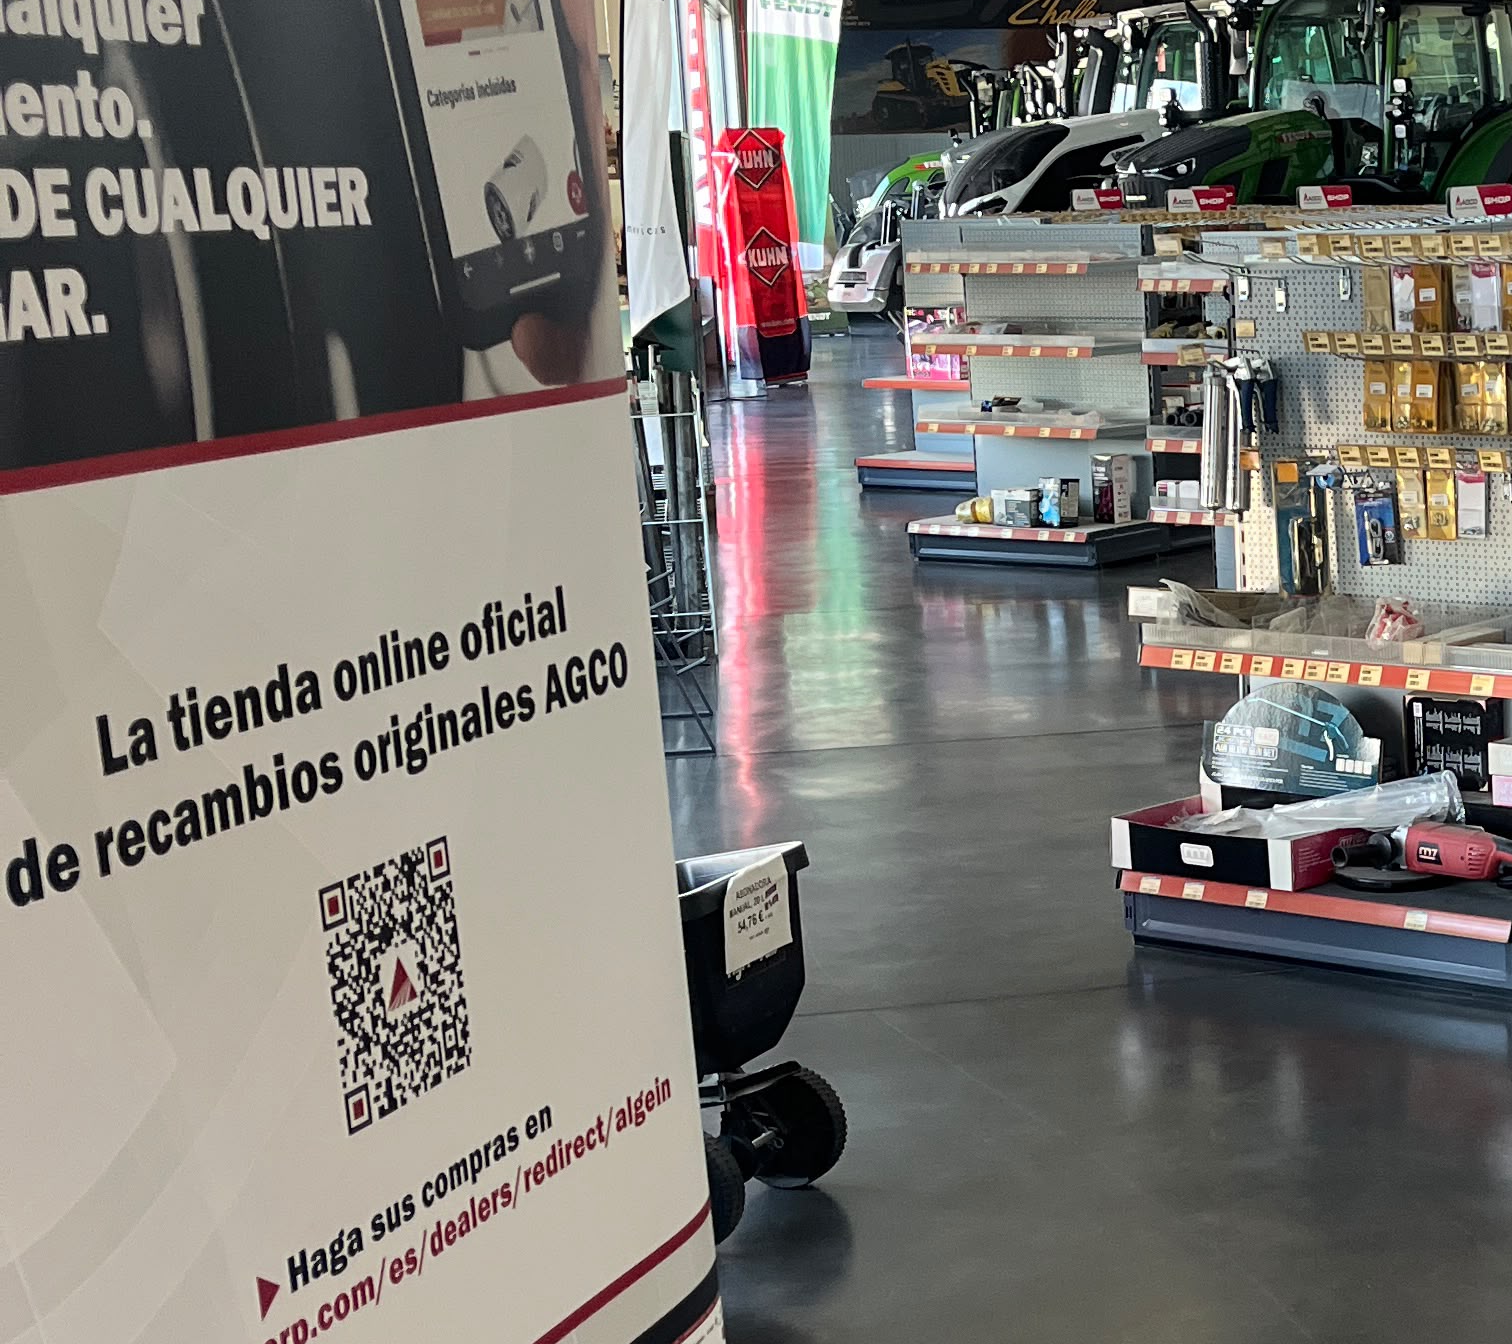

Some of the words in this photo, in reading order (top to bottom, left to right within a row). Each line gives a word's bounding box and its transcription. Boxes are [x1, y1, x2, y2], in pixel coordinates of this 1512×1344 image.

[476, 74, 517, 101] Incluidas
[0, 70, 152, 140] ento.
[736, 149, 775, 169] KUHN
[0, 167, 76, 240] DE
[86, 166, 372, 240] CUALQUIER
[1200, 197, 1225, 206] SHOP
[1326, 194, 1350, 202] SHOP
[1484, 195, 1511, 205] SHOP
[748, 246, 790, 268] KUHN
[96, 712, 159, 776] La
[166, 662, 322, 754] tienda
[332, 628, 451, 702] online
[459, 585, 568, 661] oficial
[4, 836, 81, 908] de
[94, 751, 345, 878] recambios
[353, 702, 536, 776] originales
[543, 641, 630, 715] AGCO
[286, 1224, 364, 1294] Haga
[370, 1198, 416, 1243] sus
[421, 1126, 520, 1216] compras
[524, 1102, 553, 1142] en
